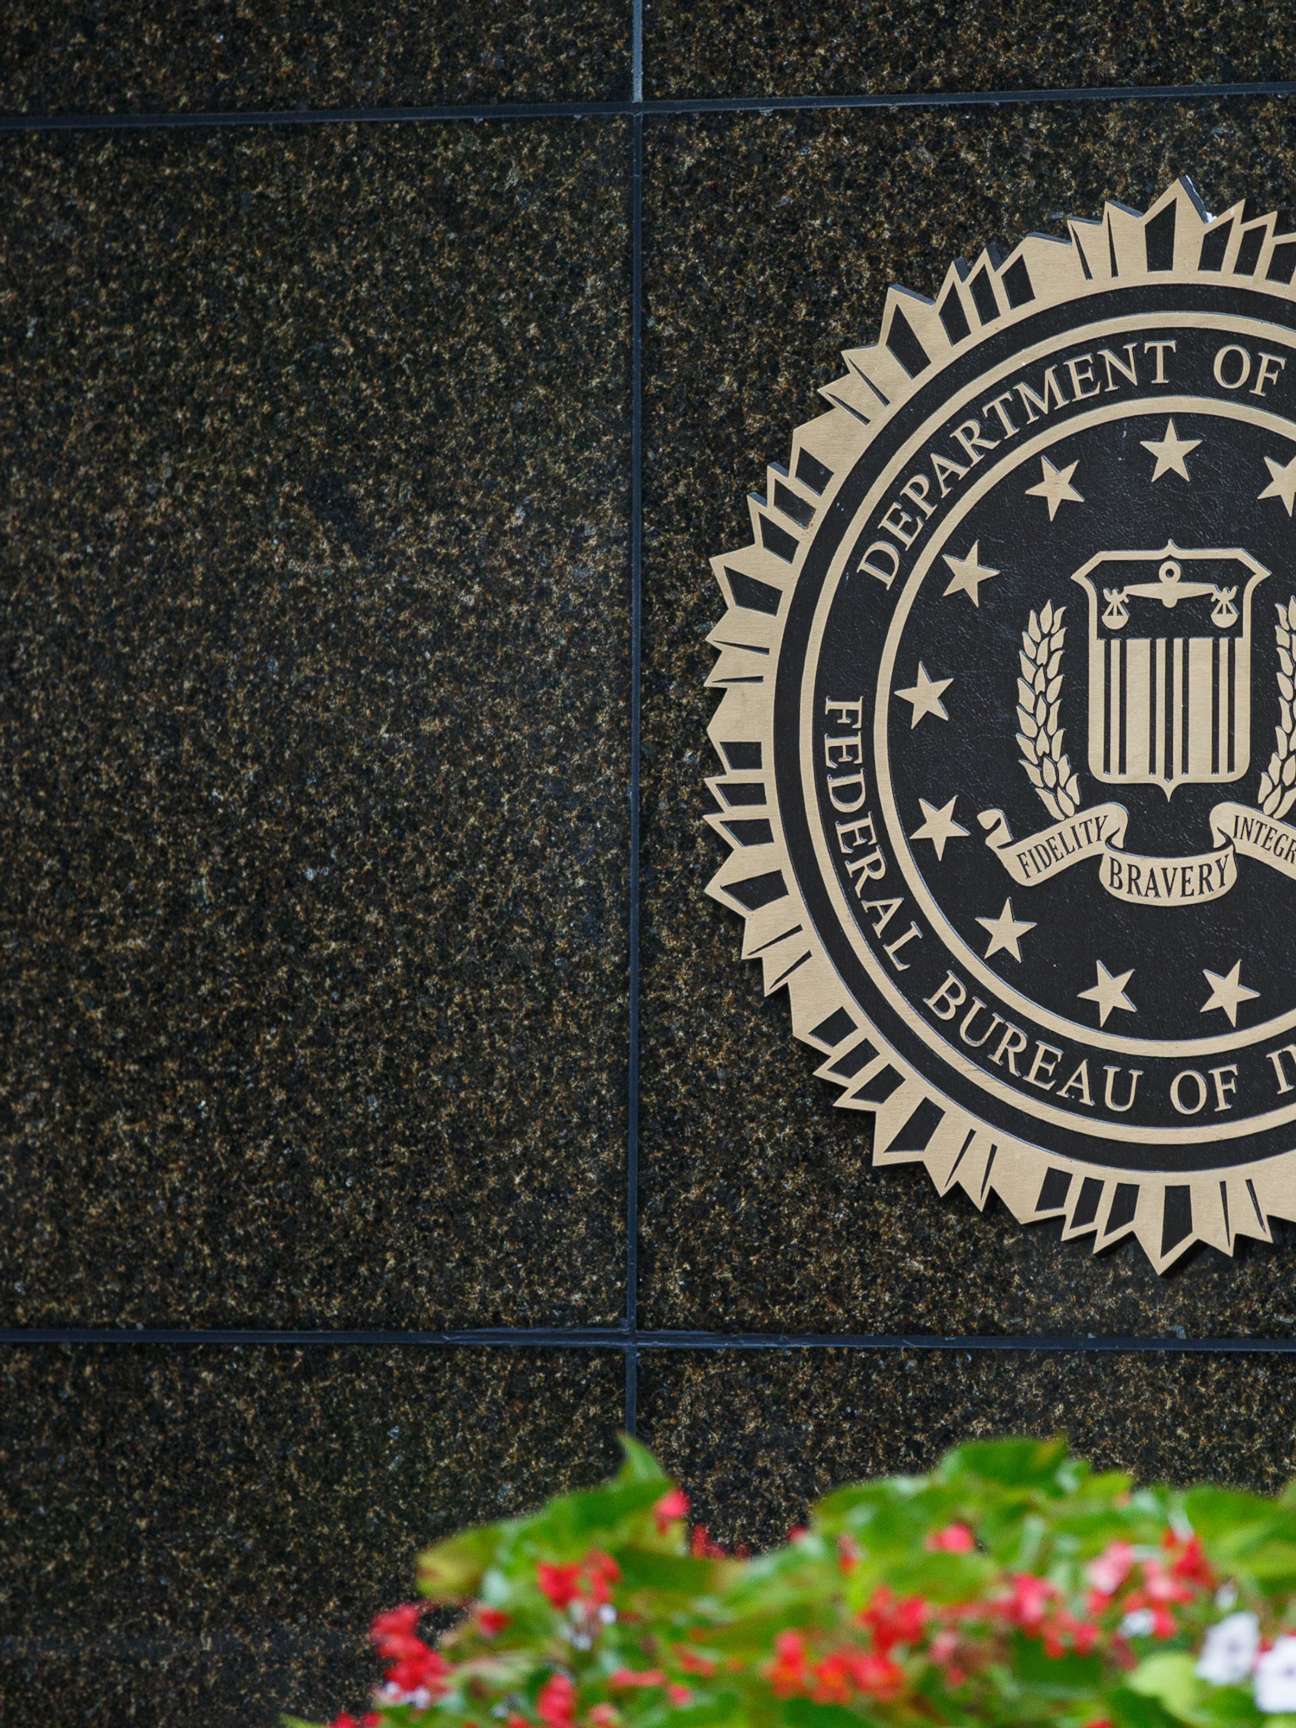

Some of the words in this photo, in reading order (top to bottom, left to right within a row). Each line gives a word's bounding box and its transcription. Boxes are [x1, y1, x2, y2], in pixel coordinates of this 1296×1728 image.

[857, 341, 1177, 591] DEPARTMENT
[1213, 345, 1286, 400] OF
[824, 696, 925, 973] FEDERAL
[923, 971, 1144, 1114] BUREAU
[1170, 1065, 1239, 1115] OF
[1016, 815, 1109, 879] FIDELITY
[1108, 856, 1231, 898] BRAVERY
